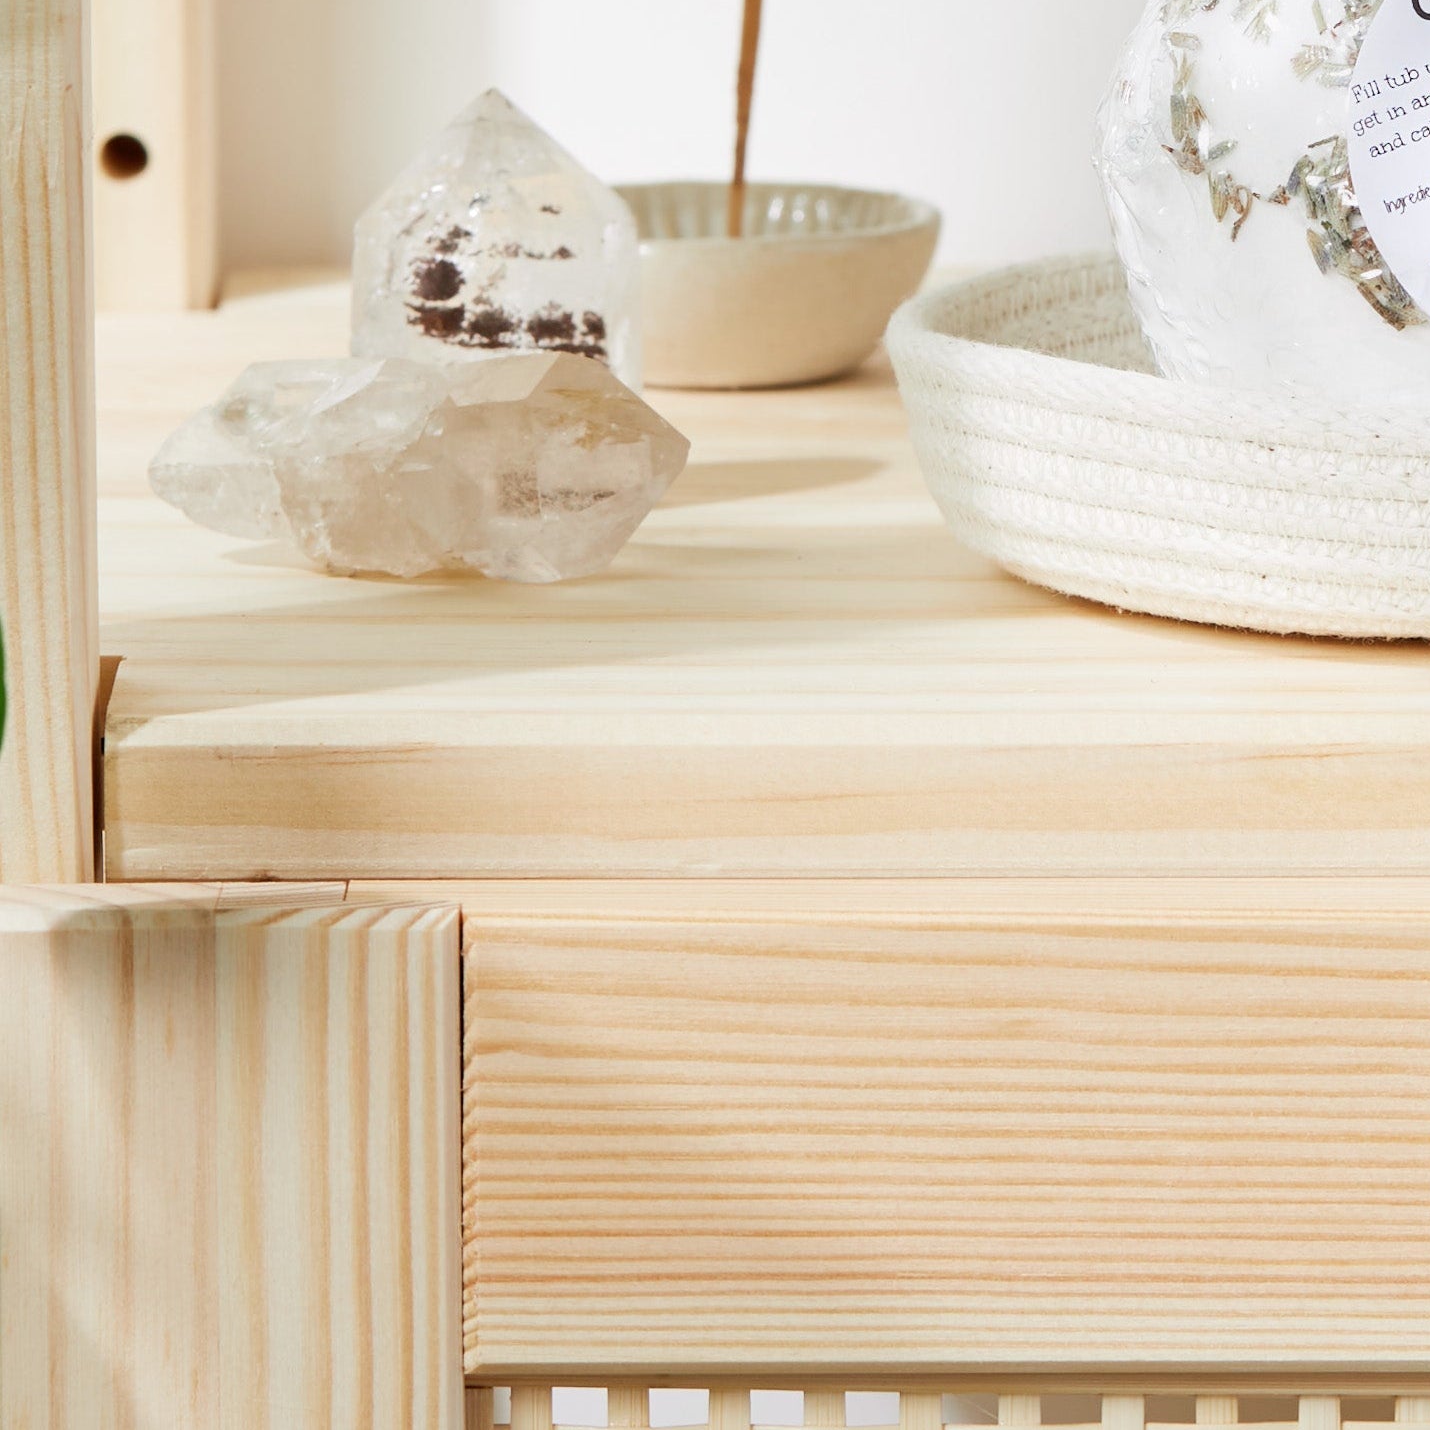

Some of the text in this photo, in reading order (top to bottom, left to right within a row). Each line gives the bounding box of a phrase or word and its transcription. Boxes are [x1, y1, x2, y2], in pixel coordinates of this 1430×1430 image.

[1350, 80, 1381, 104] Fill
[1384, 67, 1420, 91] tub
[1352, 112, 1382, 137] get
[1387, 104, 1407, 121] in
[1369, 132, 1406, 158] and
